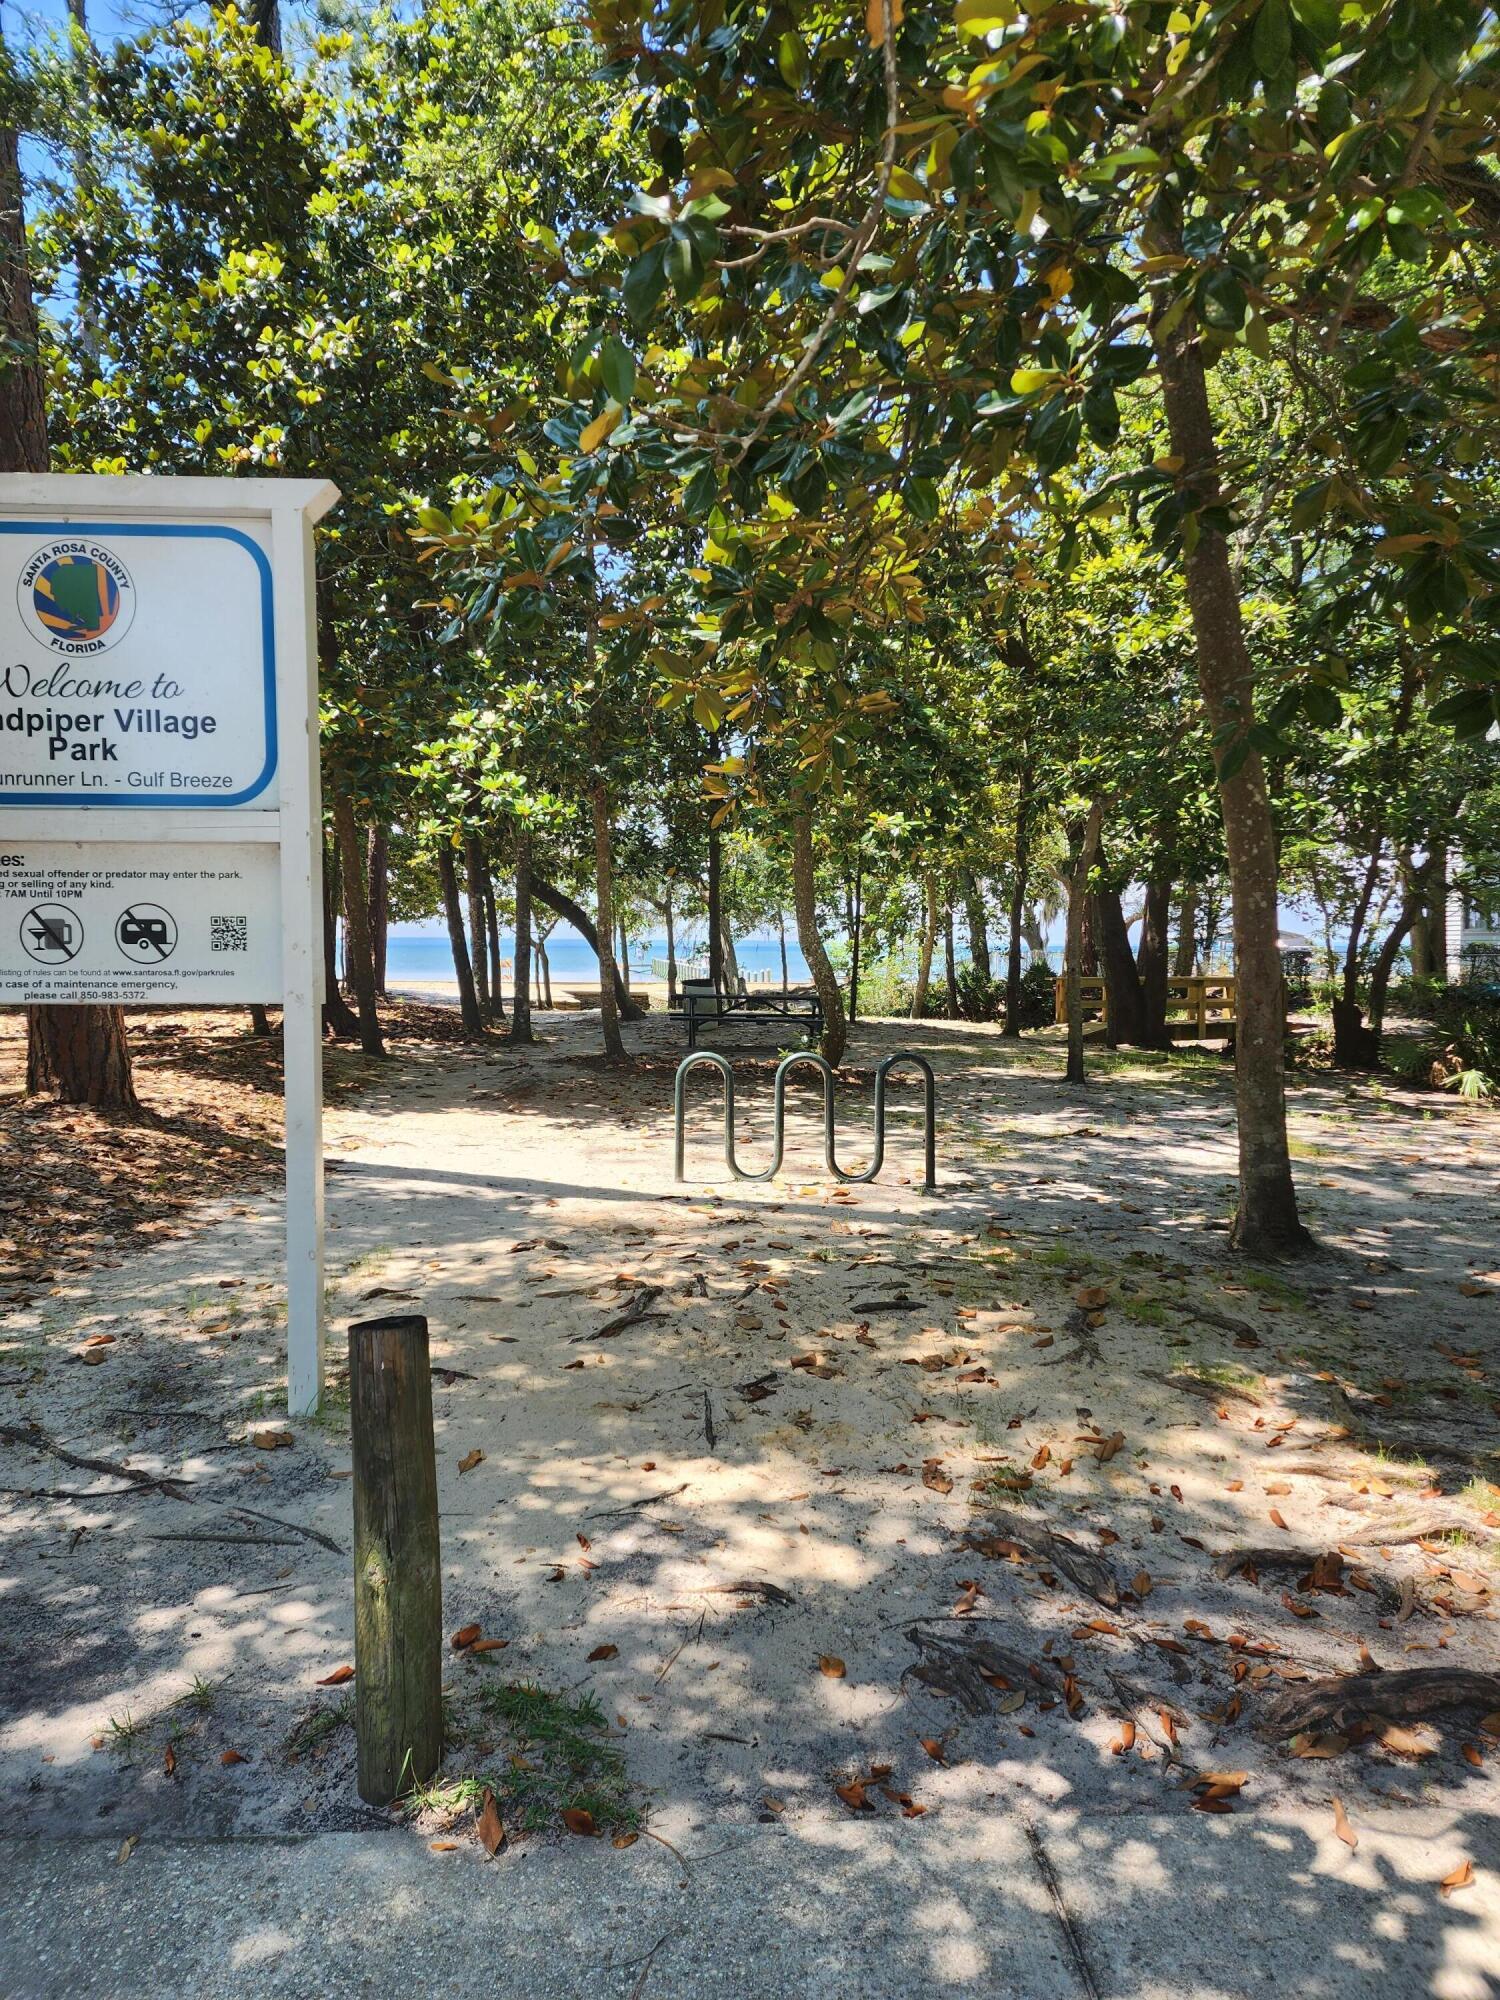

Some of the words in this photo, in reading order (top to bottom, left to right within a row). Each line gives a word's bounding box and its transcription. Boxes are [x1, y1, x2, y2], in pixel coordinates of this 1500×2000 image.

[23, 552, 51, 587] SANTA
[52, 543, 86, 556] ROSA
[90, 547, 130, 589] COUNTY
[51, 638, 106, 653] FLORIDA
[150, 672, 184, 699] to
[114, 708, 217, 739] Village
[49, 736, 118, 761] Park
[81, 771, 108, 787] Ln.
[128, 771, 165, 787] Gulf
[170, 772, 233, 788] Breeze
[12, 869, 45, 878] sexual
[47, 869, 90, 878] offender
[105, 870, 147, 880] predator
[149, 871, 170, 880] may
[172, 870, 198, 879] enter
[200, 870, 216, 879] the
[218, 870, 243, 881] park.
[21, 879, 54, 889] selling
[57, 879, 67, 888] of
[69, 881, 87, 890] any
[90, 880, 114, 889] kind.
[4, 889, 27, 898] 7AM
[29, 889, 53, 898] Until
[56, 890, 82, 898] 10PM
[5, 981, 29, 989] case
[32, 980, 42, 989] of
[45, 981, 51, 989] a
[53, 980, 118, 989] maintenance
[121, 980, 178, 990] emergency,
[24, 991, 57, 1001] please
[59, 991, 78, 1000] call
[80, 991, 149, 1000] 850-983-5372.
